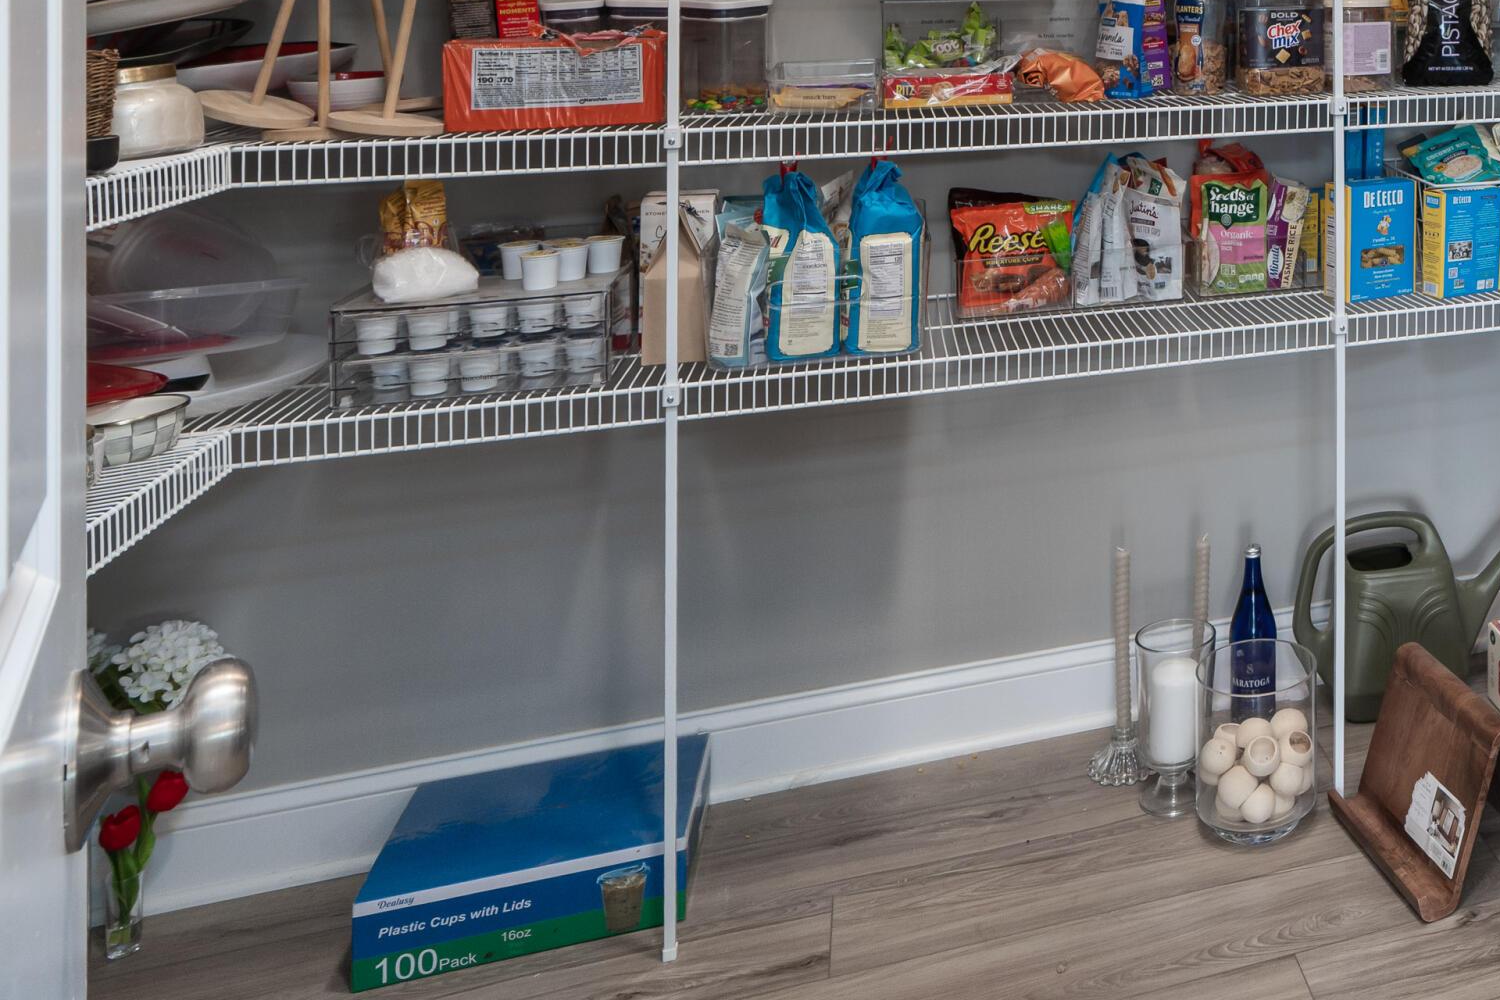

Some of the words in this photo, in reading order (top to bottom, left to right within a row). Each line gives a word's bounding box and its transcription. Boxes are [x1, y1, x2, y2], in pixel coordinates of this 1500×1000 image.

[499, 6, 536, 16] MOMENTS
[1270, 11, 1299, 19] BOLD
[1267, 20, 1302, 39] Chex
[1272, 34, 1300, 50] mix
[477, 76, 494, 84] 190
[896, 82, 916, 97] RITZ
[1209, 187, 1247, 201] Seeds
[1376, 189, 1404, 207] CECCO
[1459, 195, 1472, 204] CECCO
[1030, 203, 1065, 211] SHARE
[969, 223, 1048, 254] Reese
[1220, 230, 1254, 239] Organic
[1288, 224, 1298, 246] RICE
[1283, 246, 1295, 285] JASMINE
[1232, 676, 1270, 688] SARATOGA
[377, 918, 428, 939] Plastic
[430, 911, 467, 931] Cups
[470, 903, 500, 920] with
[502, 898, 533, 914] Lids
[500, 928, 533, 943] 16oz
[374, 948, 439, 985] 100
[438, 951, 479, 972] Pack
